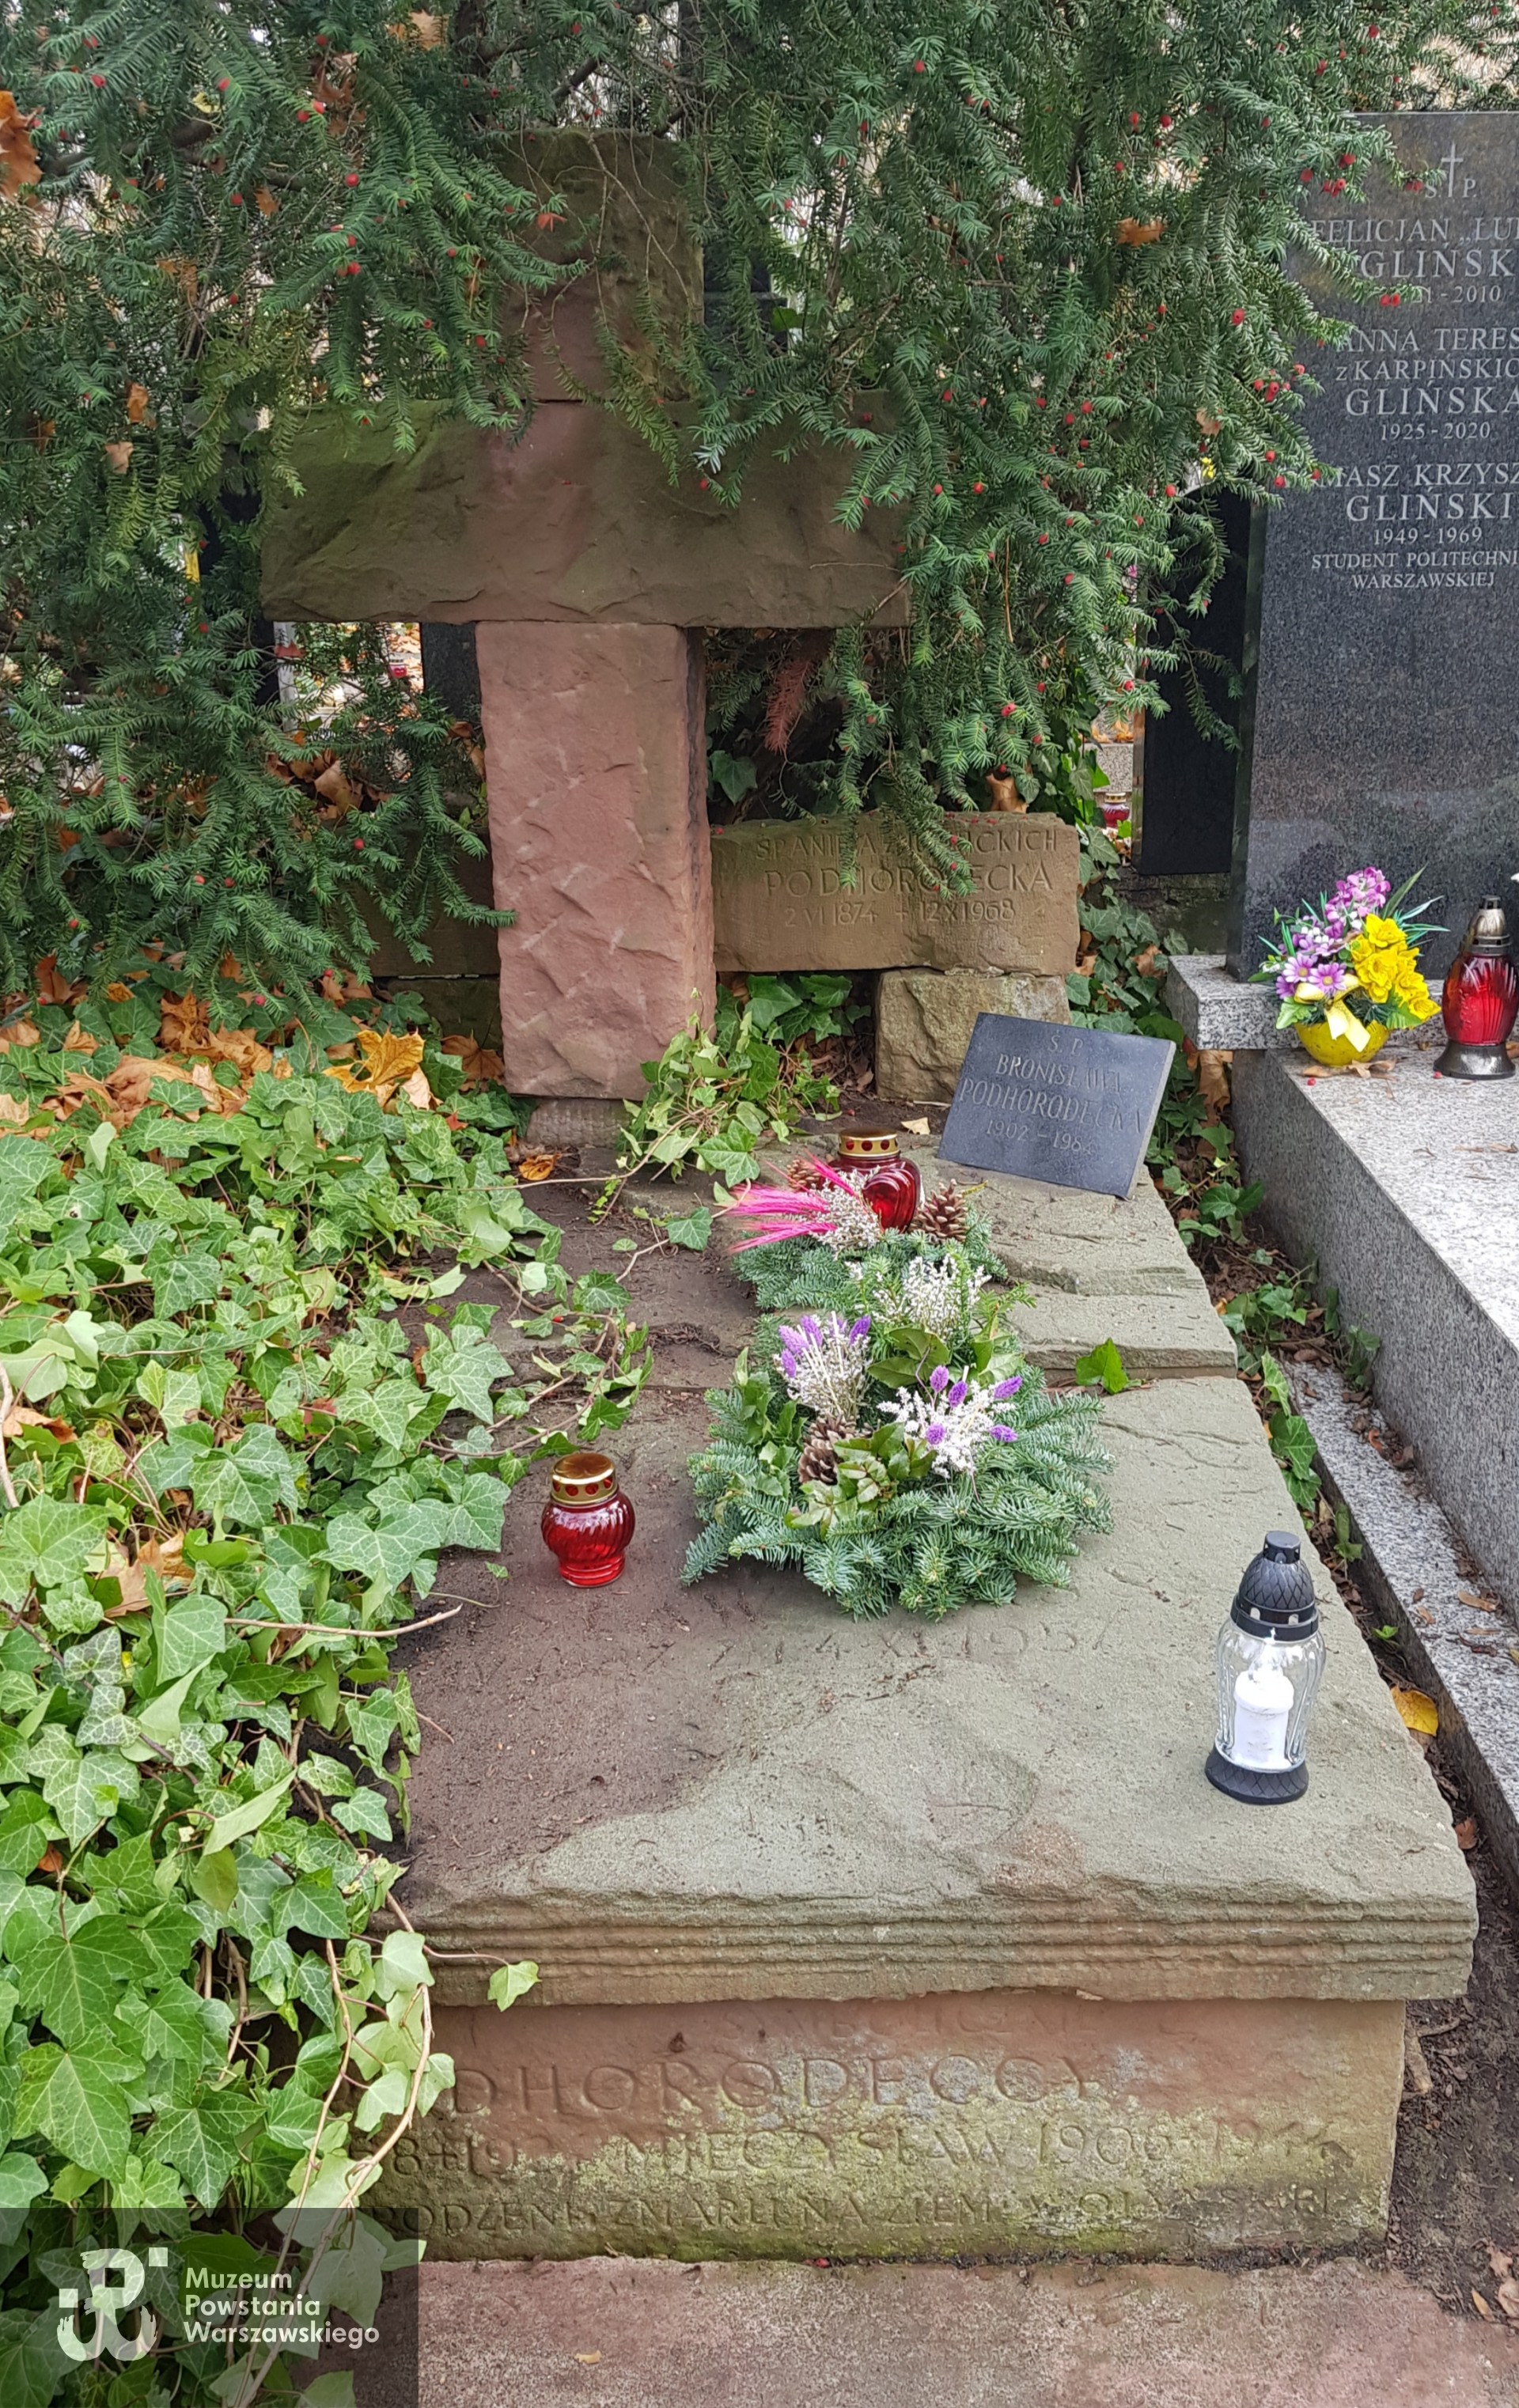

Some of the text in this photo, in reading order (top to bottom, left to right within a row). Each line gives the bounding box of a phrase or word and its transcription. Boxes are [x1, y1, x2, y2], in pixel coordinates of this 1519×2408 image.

[1453, 285, 1501, 303] 2010
[1381, 422, 1426, 441] 1925
[1443, 422, 1491, 440] 2020
[1318, 464, 1400, 488] MASZ
[1346, 486, 1514, 522] GLIŃSKI
[1374, 528, 1419, 546] 1949
[1438, 526, 1483, 544] 1969
[1311, 553, 1400, 570] STUDENT
[1352, 571, 1495, 589] WARSZAWSKIEJ
